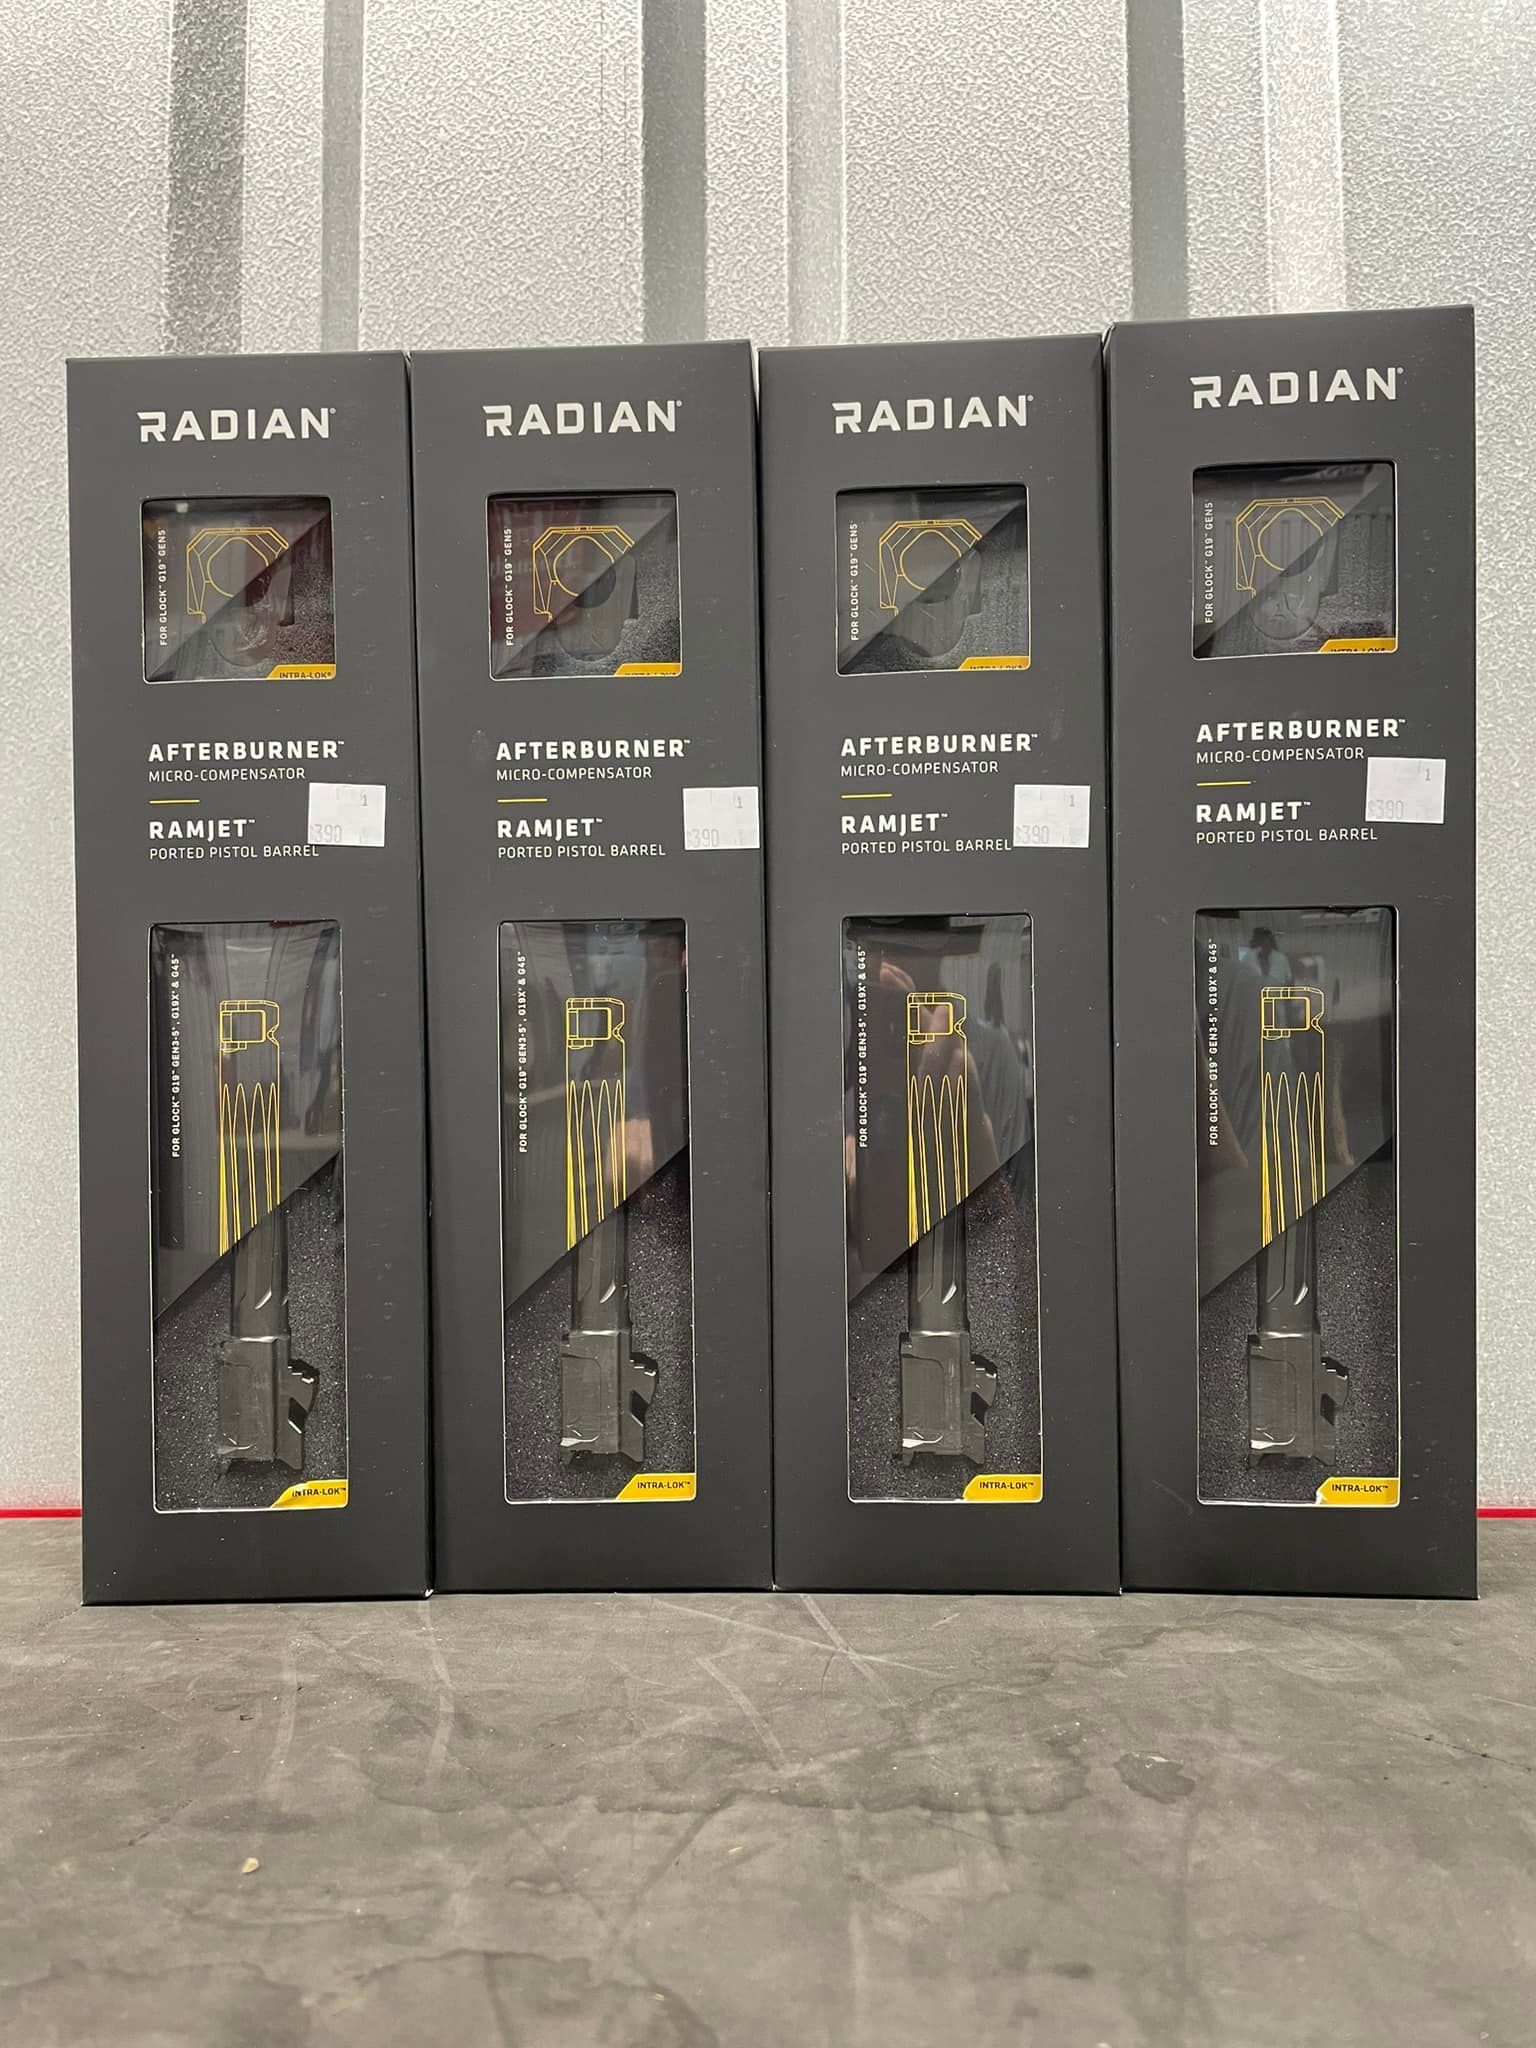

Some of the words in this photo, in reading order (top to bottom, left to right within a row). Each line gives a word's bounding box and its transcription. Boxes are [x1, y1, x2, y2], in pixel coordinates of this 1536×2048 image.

[1204, 602, 1214, 624] FOR
[159, 625, 168, 646] FOR
[505, 626, 514, 646] FOR
[850, 620, 860, 641] FOR
[1197, 747, 1363, 763] MICRO-COMPENSATOR
[149, 768, 305, 782] MICRO-COMPENSATOR
[497, 767, 651, 781] MICRO-COMPENSATOR
[841, 761, 998, 776] MICRO-COMPENSATOR
[1197, 831, 1255, 843] PORTED
[1262, 830, 1312, 842] PISTOL
[1319, 828, 1377, 840] BARREL
[150, 847, 204, 859] PORTED
[210, 847, 257, 857] PISTOL
[264, 845, 319, 857] BARREL
[499, 847, 552, 858] PORTED
[558, 845, 605, 857] PISTOL
[611, 844, 665, 856] BARREL
[842, 842, 896, 854] PORTED
[902, 840, 950, 852] PISTOL
[956, 839, 1011, 851] BARREL
[518, 1132, 528, 1153] FOR
[859, 1127, 868, 1148] FOR
[1209, 1125, 1219, 1146] FOR
[171, 1137, 181, 1158] FOR
